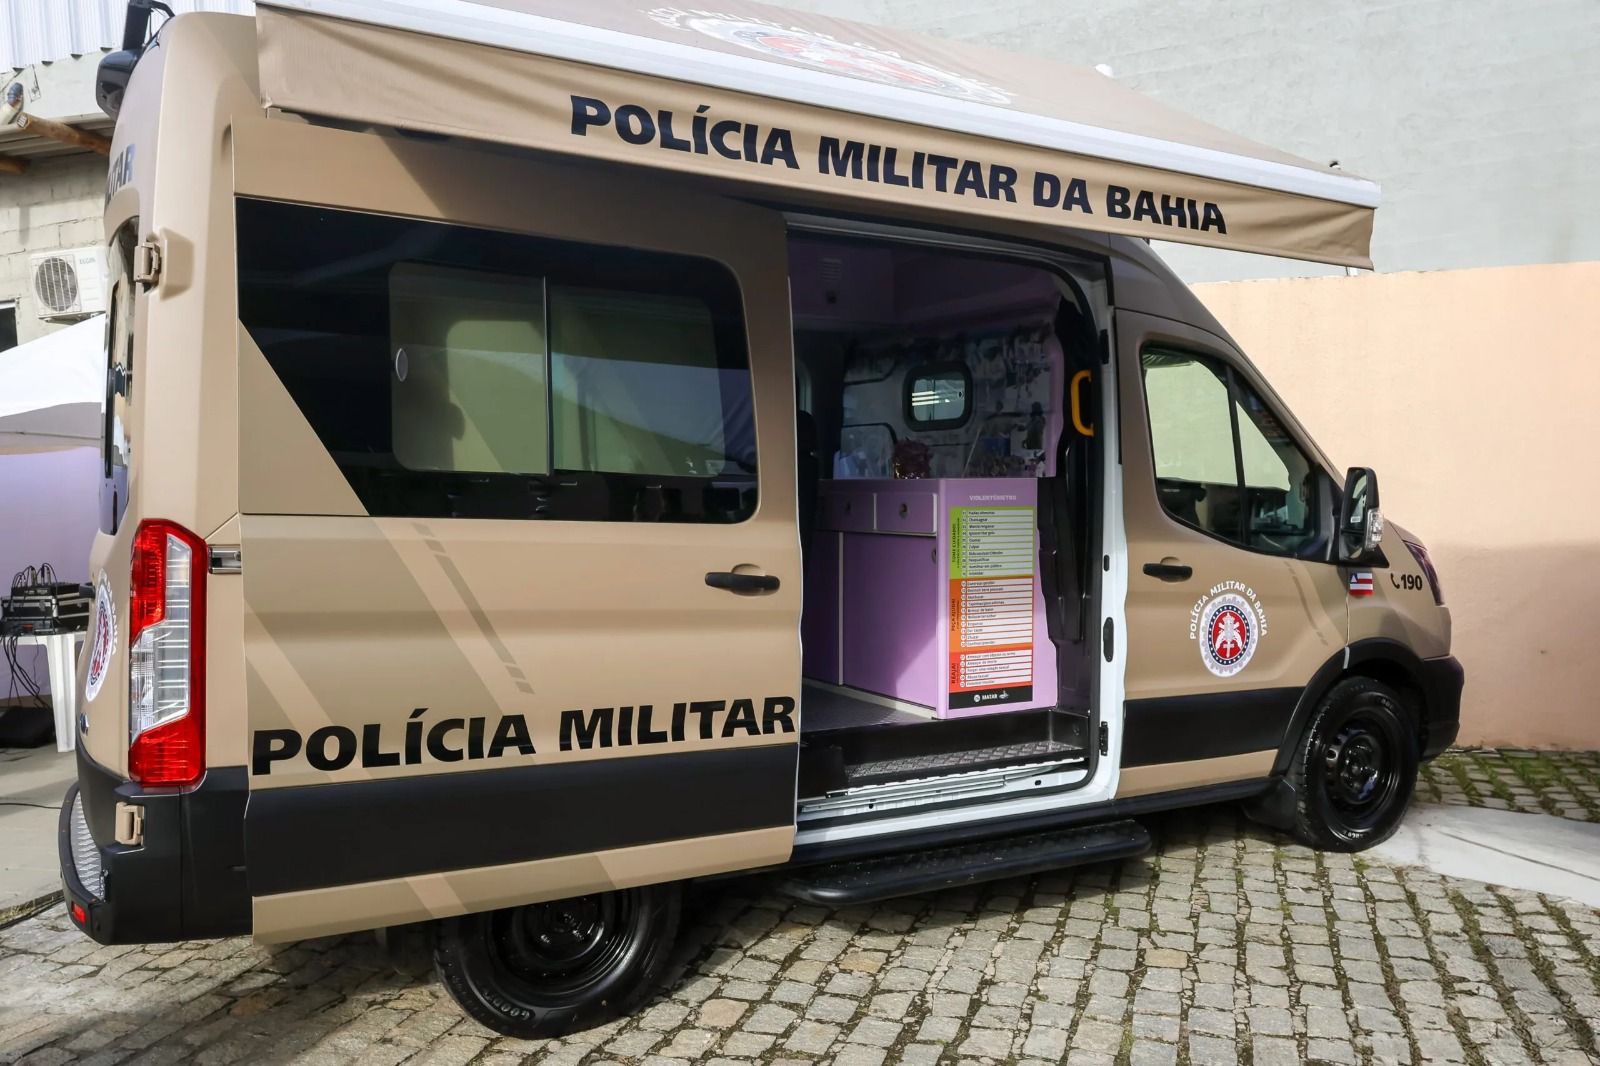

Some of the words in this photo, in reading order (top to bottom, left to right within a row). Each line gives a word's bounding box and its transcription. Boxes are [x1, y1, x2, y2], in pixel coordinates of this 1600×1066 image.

[570, 94, 800, 170] POLÍCIA
[818, 135, 1017, 203] MILITAR
[1033, 171, 1093, 215] DA
[1106, 184, 1228, 235] BAHIA
[1190, 594, 1209, 640] POLÍCIA
[1210, 581, 1246, 597] MILITAR
[1246, 588, 1257, 602] DA
[1254, 601, 1268, 636] BAHIA
[1401, 574, 1423, 591] 190
[252, 707, 537, 776] POLÍCIA
[559, 696, 796, 751] MILITAR
